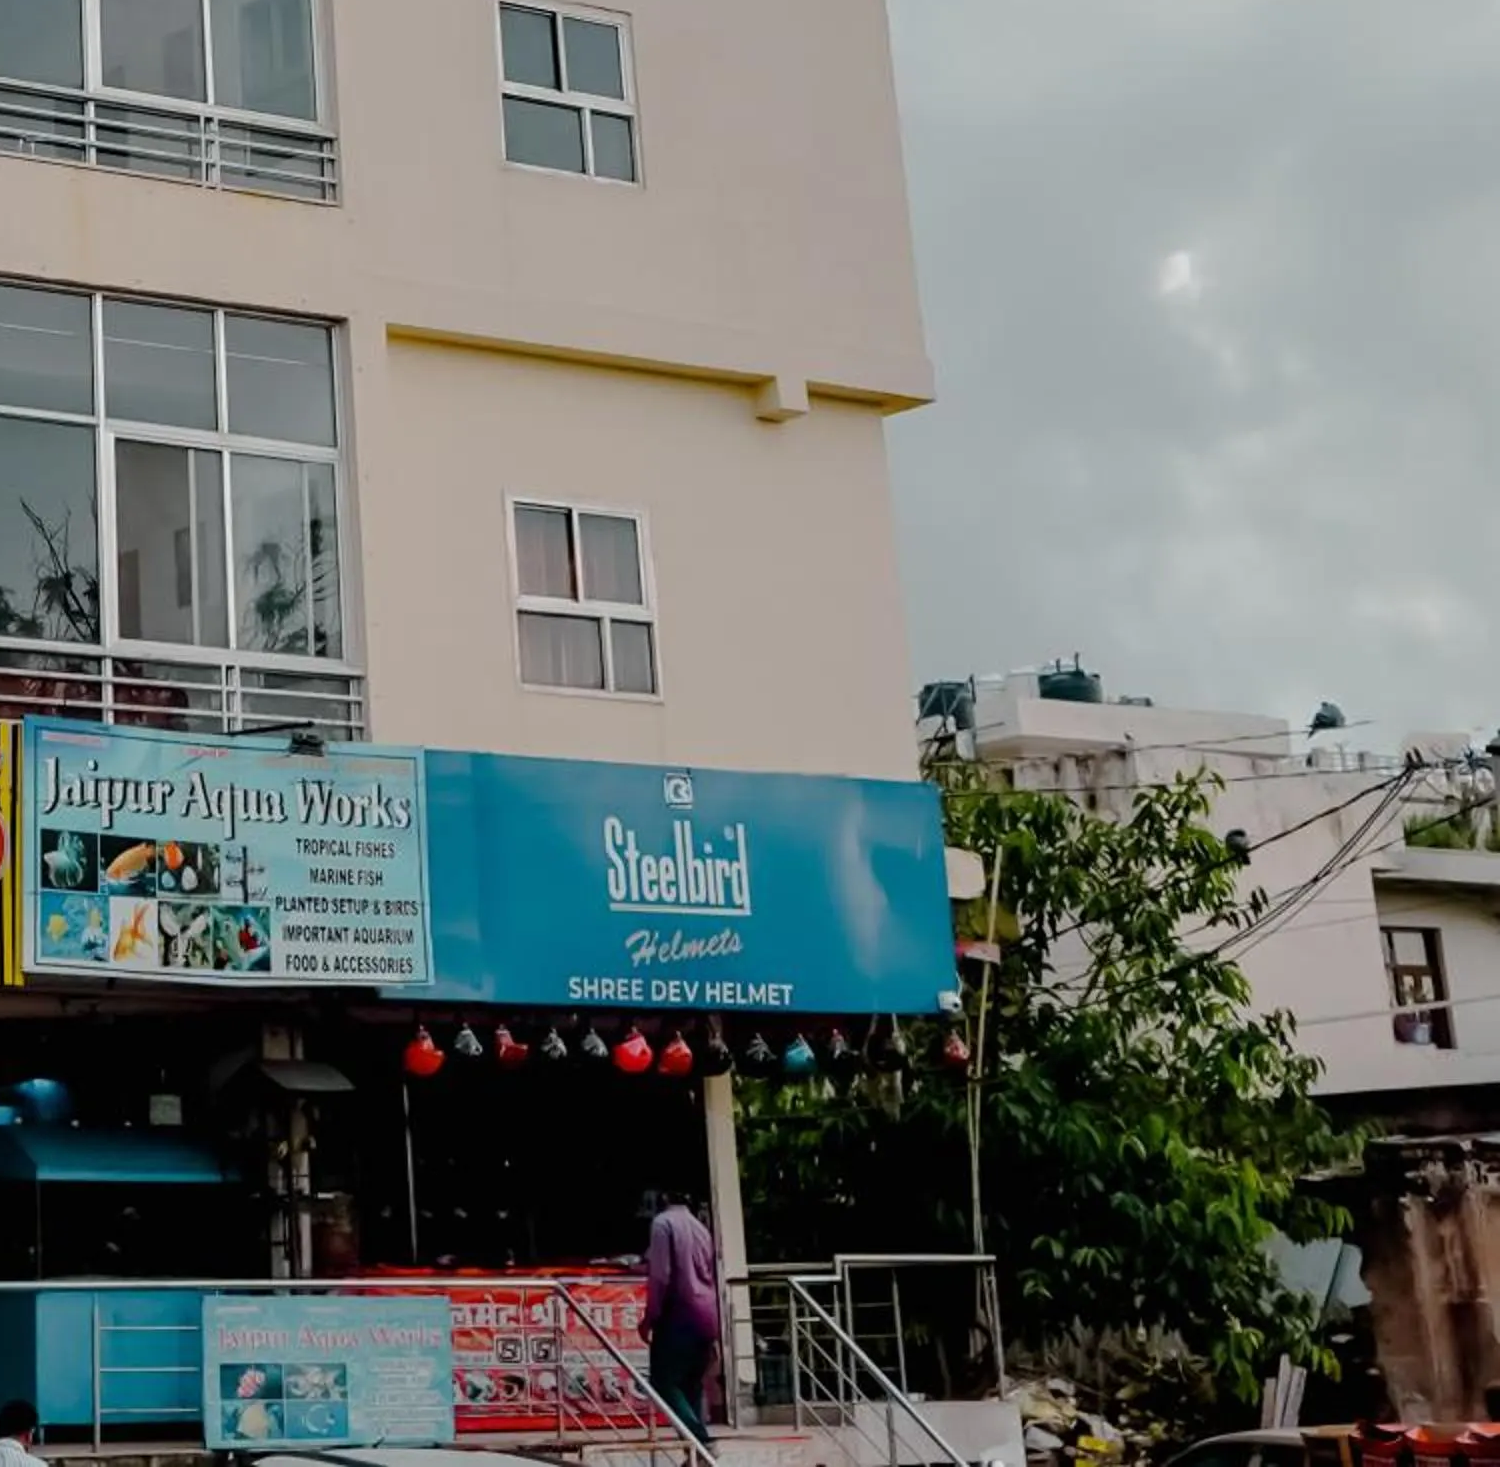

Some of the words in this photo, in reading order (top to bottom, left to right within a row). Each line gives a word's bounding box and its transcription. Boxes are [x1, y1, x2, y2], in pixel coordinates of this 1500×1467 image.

[41, 755, 175, 830] Jaipur
[179, 770, 288, 841] Aqua
[294, 777, 412, 830] Works
[295, 837, 352, 857] TROPICAL
[355, 840, 396, 859] FISHES
[604, 815, 751, 911] Steelbird
[309, 867, 354, 886] MARINE
[357, 869, 384, 887] FISH
[274, 895, 329, 914] PLANTED
[331, 897, 369, 915] SETUP
[373, 899, 381, 916] &
[281, 924, 350, 944] IMPORTANT
[353, 927, 415, 945] AQUARIUM
[624, 927, 743, 968] Helmets
[285, 954, 318, 973] FOOD
[321, 956, 331, 973] &
[333, 956, 414, 975] ACCESSORIES
[568, 976, 644, 1002] SHREE
[650, 979, 700, 1003] DEV
[704, 982, 794, 1006] HELMET
